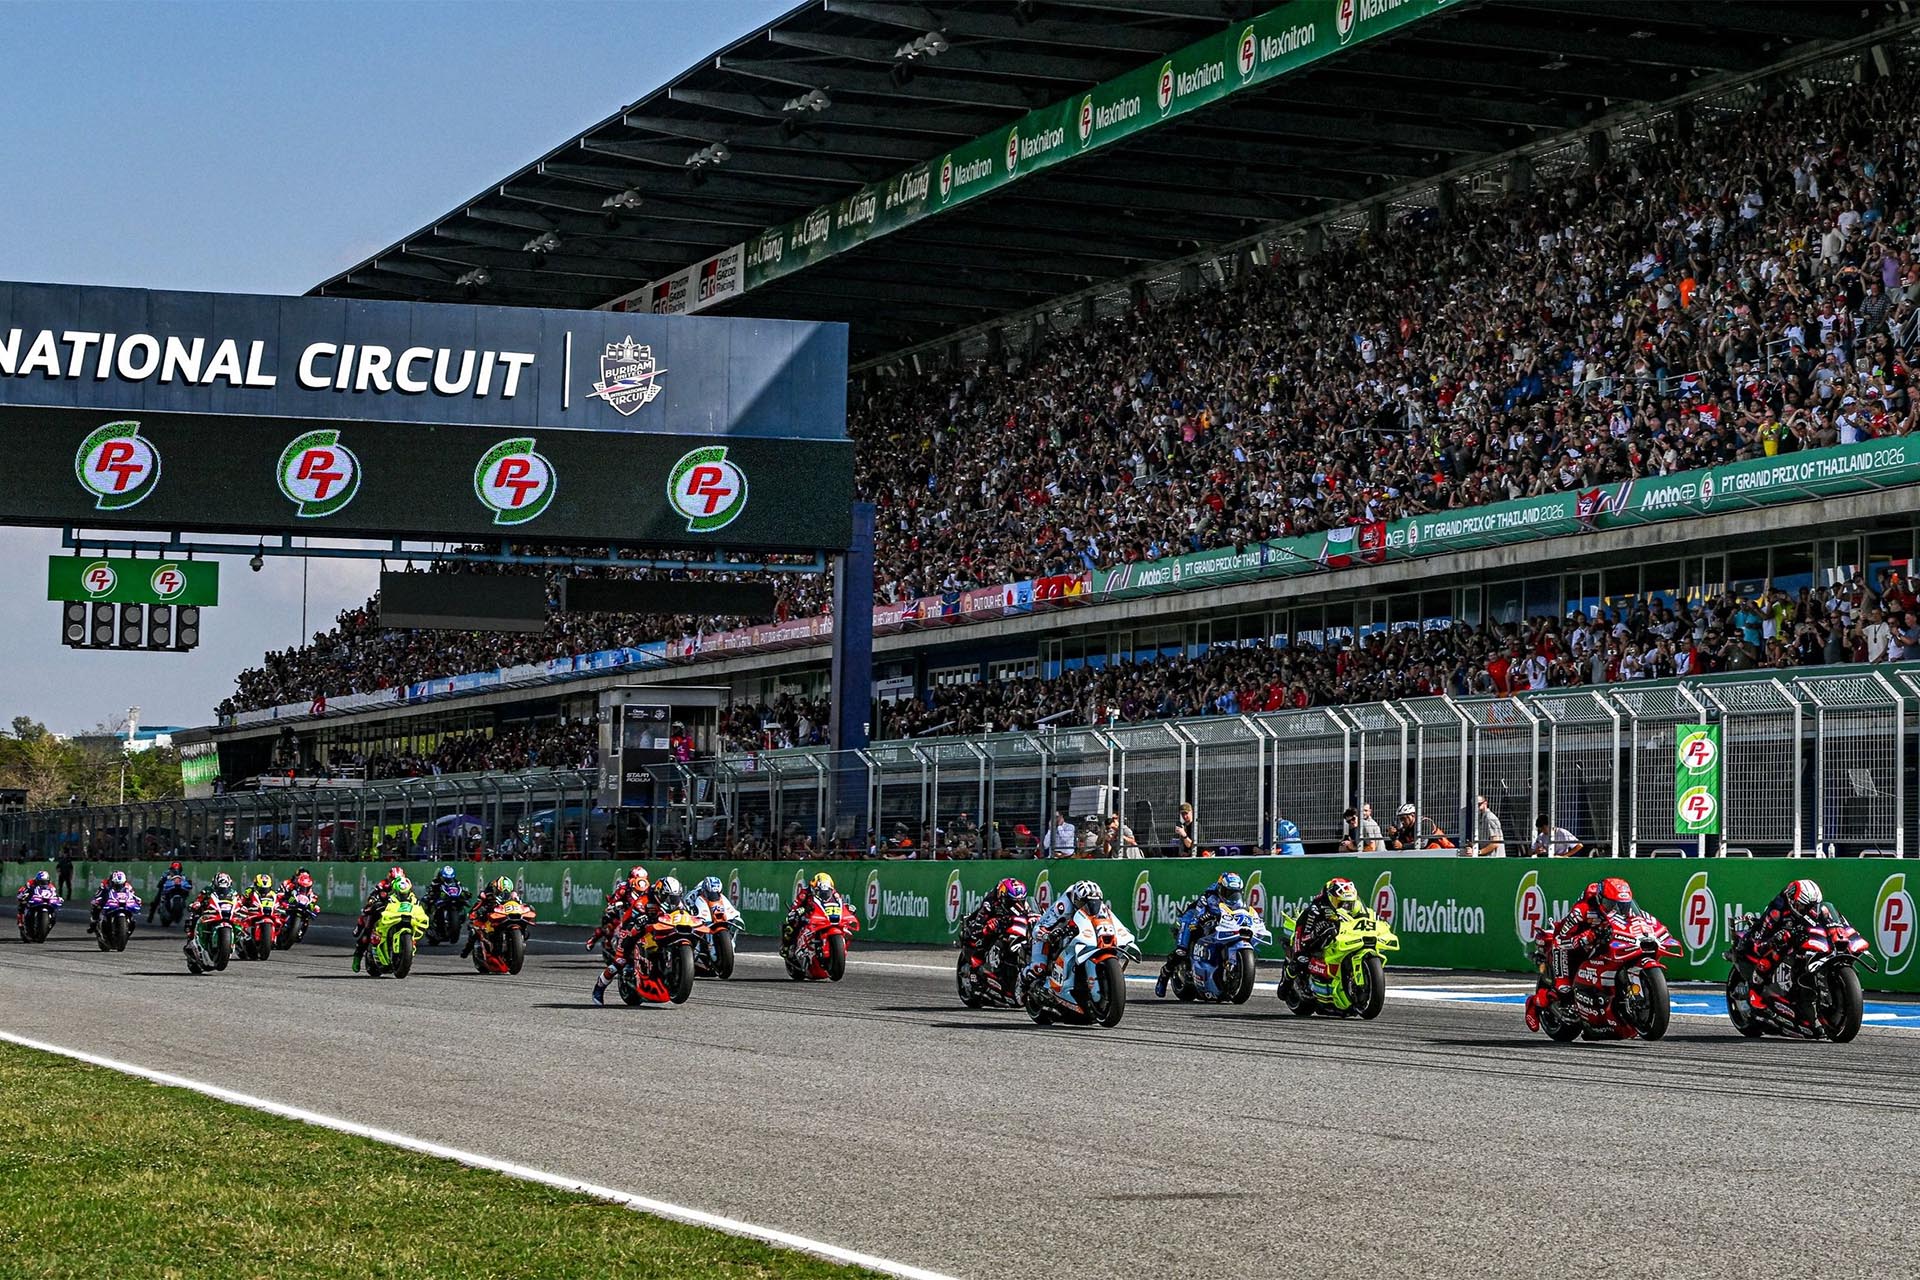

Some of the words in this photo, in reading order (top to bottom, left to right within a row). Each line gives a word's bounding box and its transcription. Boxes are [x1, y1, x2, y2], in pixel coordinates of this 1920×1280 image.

[1260, 22, 1315, 63] Maxnitron
[1177, 61, 1224, 97] Maxnitron
[1096, 95, 1140, 131] Maxnitron
[1021, 127, 1063, 160] Maxnitron
[900, 171, 930, 203] Chang
[954, 158, 992, 187] Maxnitron
[849, 195, 876, 224] Chang
[804, 215, 830, 245] Chang
[758, 235, 783, 263] Chang
[300, 343, 535, 397] CIRCUIT
[605, 361, 652, 378] BURIRAM
[98, 442, 142, 490] PT
[299, 450, 341, 498] PT
[496, 458, 538, 506] PT
[1721, 476, 1735, 493] PT
[1736, 470, 1770, 490] GRAND
[1772, 464, 1799, 485] PRIX
[1801, 462, 1816, 480] OF
[1816, 452, 1873, 476] THAILAND
[1874, 447, 1905, 468] 2026
[689, 466, 730, 513] PT
[1424, 524, 1435, 539] PT
[1435, 520, 1462, 536] GRAND
[1463, 516, 1484, 534] PRIX
[1485, 515, 1496, 530] OF
[1496, 508, 1540, 528] THAILAND
[1541, 504, 1564, 521] 2026
[90, 569, 110, 590] PT
[159, 572, 179, 593] PT
[1185, 563, 1194, 576] PT
[1194, 560, 1215, 575] GRAND
[1215, 558, 1232, 572] PRIX
[1233, 555, 1242, 569] OF
[1688, 741, 1709, 766] PT
[1688, 796, 1708, 820] PT
[743, 887, 780, 912] Maxnitron
[883, 890, 929, 918] Maxnitron
[1137, 888, 1150, 926] PT
[1402, 898, 1485, 935] Maxnitron
[1523, 891, 1541, 938] PT
[1352, 919, 1377, 932] 49
[1689, 894, 1711, 945] PT
[1884, 898, 1909, 953] PT
